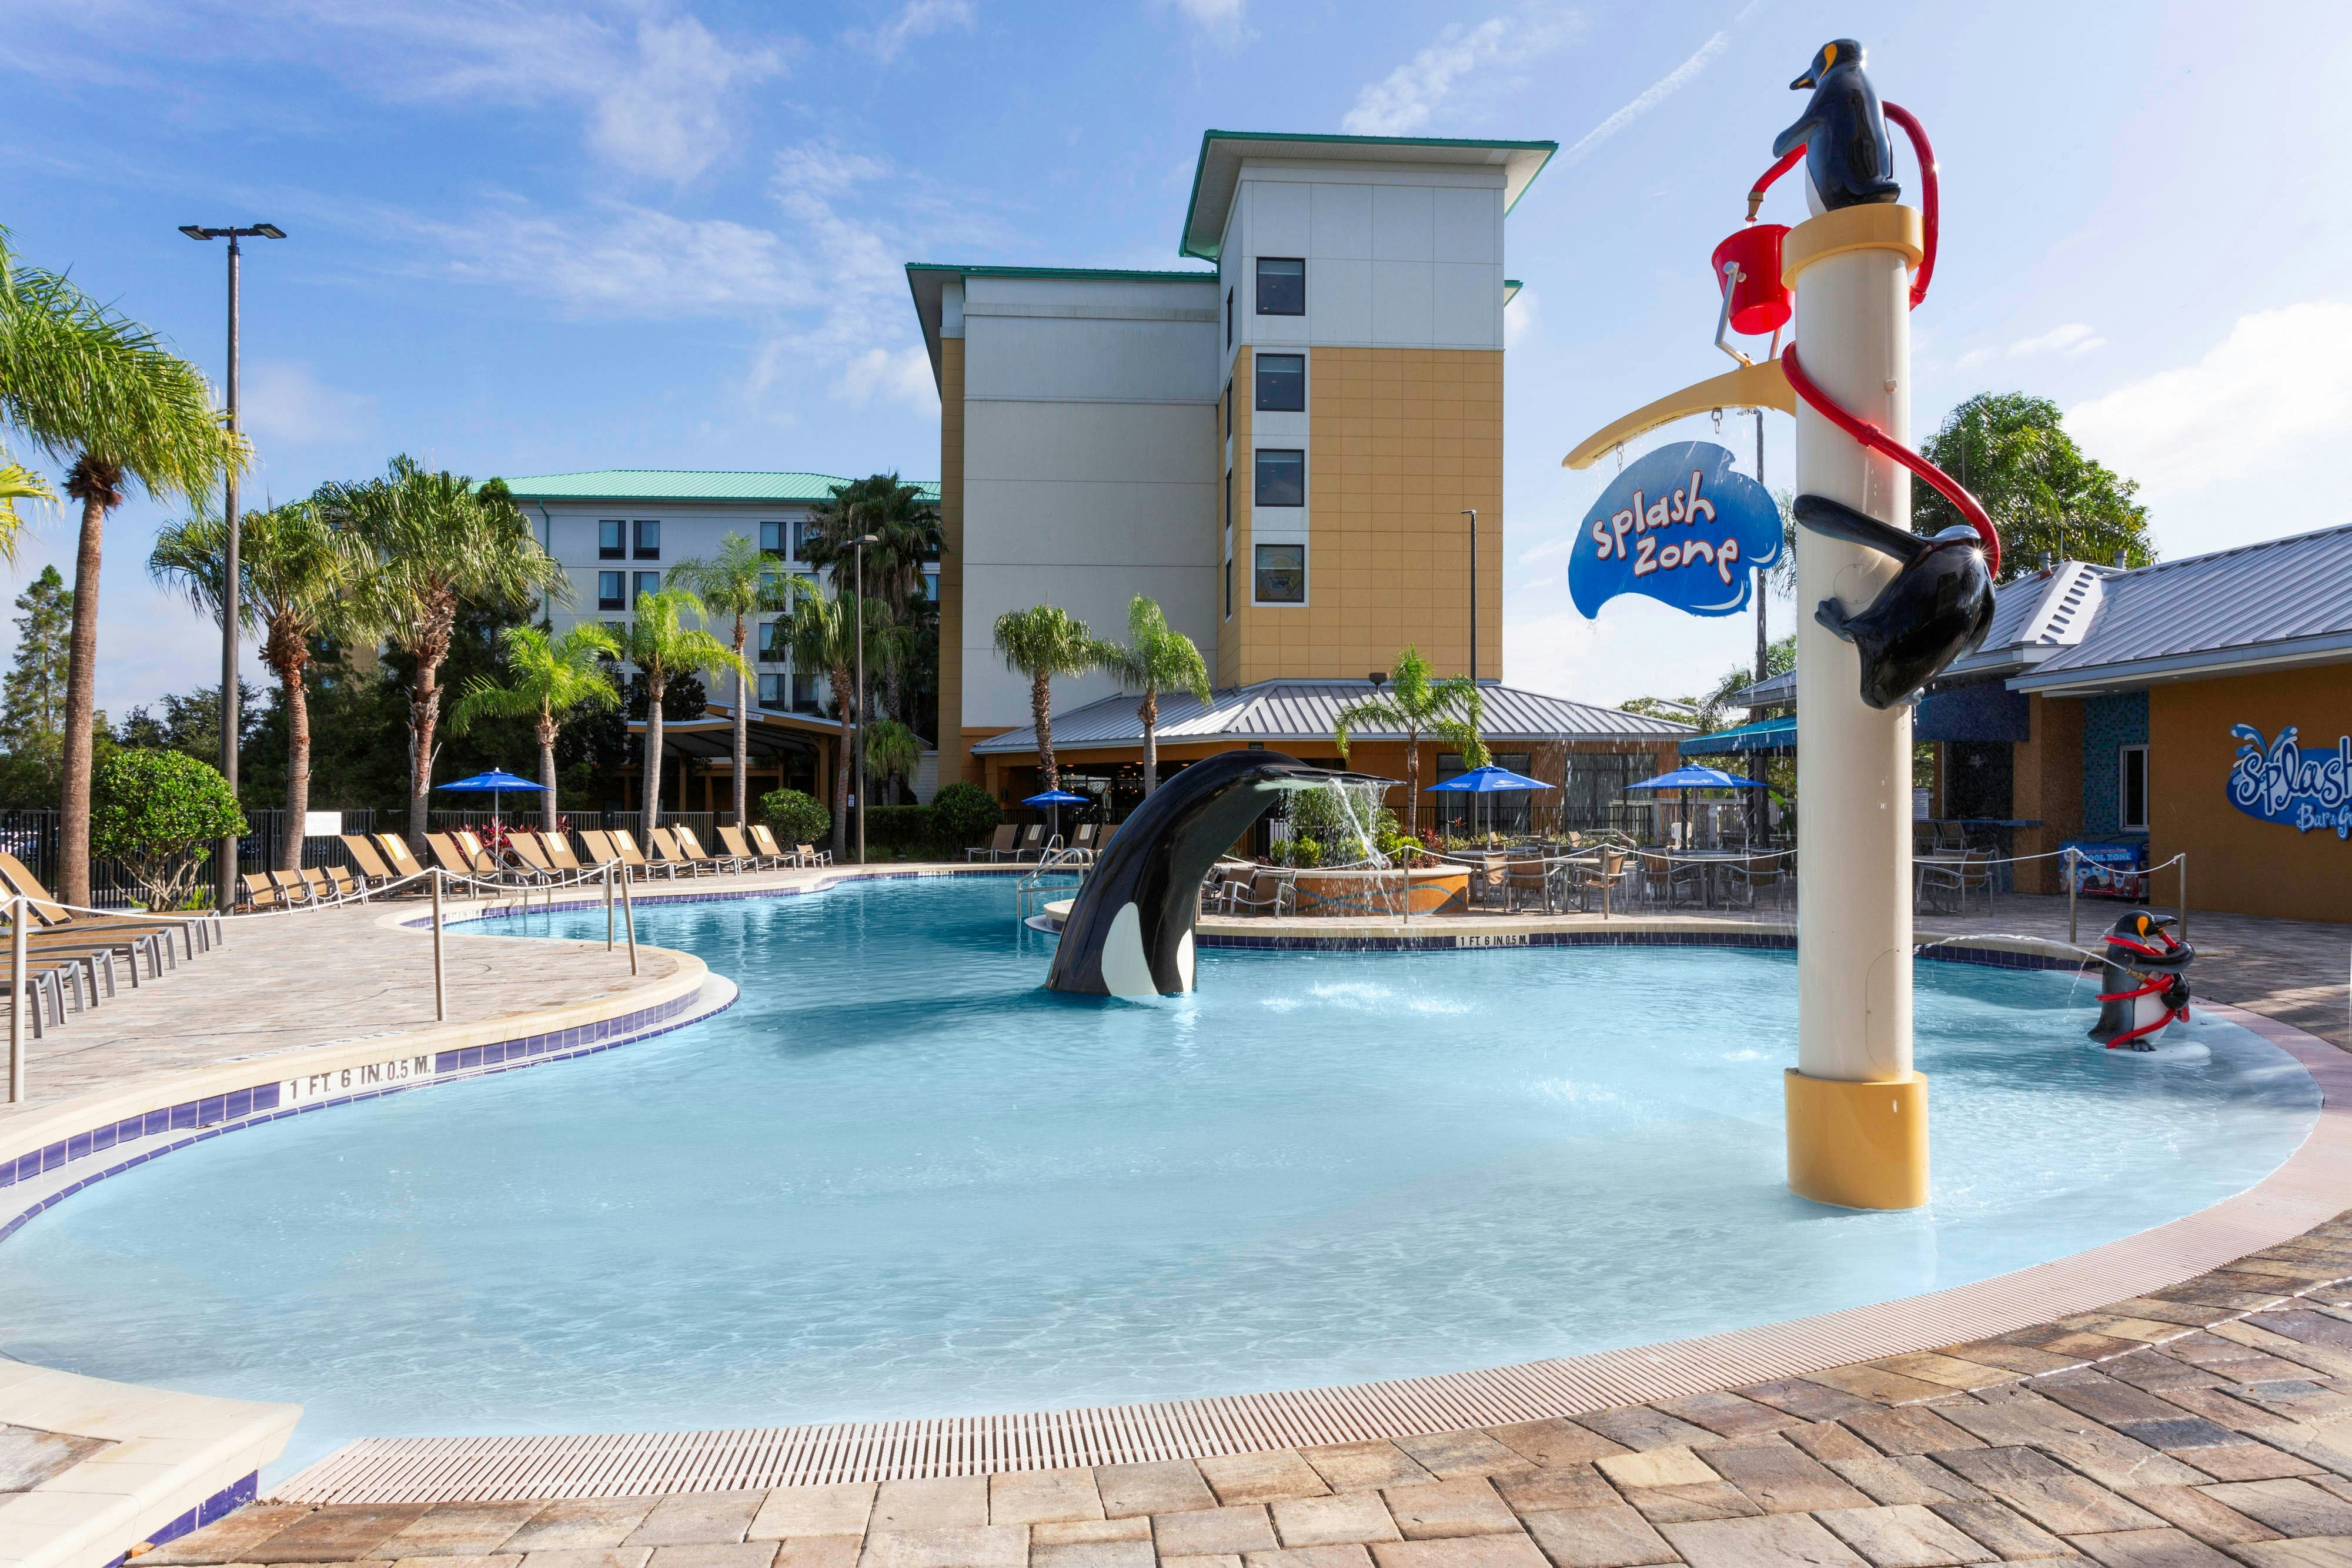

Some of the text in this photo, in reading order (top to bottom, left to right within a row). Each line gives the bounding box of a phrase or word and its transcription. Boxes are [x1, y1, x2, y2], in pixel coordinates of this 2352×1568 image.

[2296, 803, 2330, 830] Bar
[2330, 813, 2337, 824] &
[2107, 852, 2132, 861] ZONE
[1461, 937, 1465, 946] 1
[1485, 936, 1490, 945] 6
[1506, 935, 1516, 945] 0.5
[290, 1056, 430, 1099] 1 FT. 6 IN. 0.5 M.
